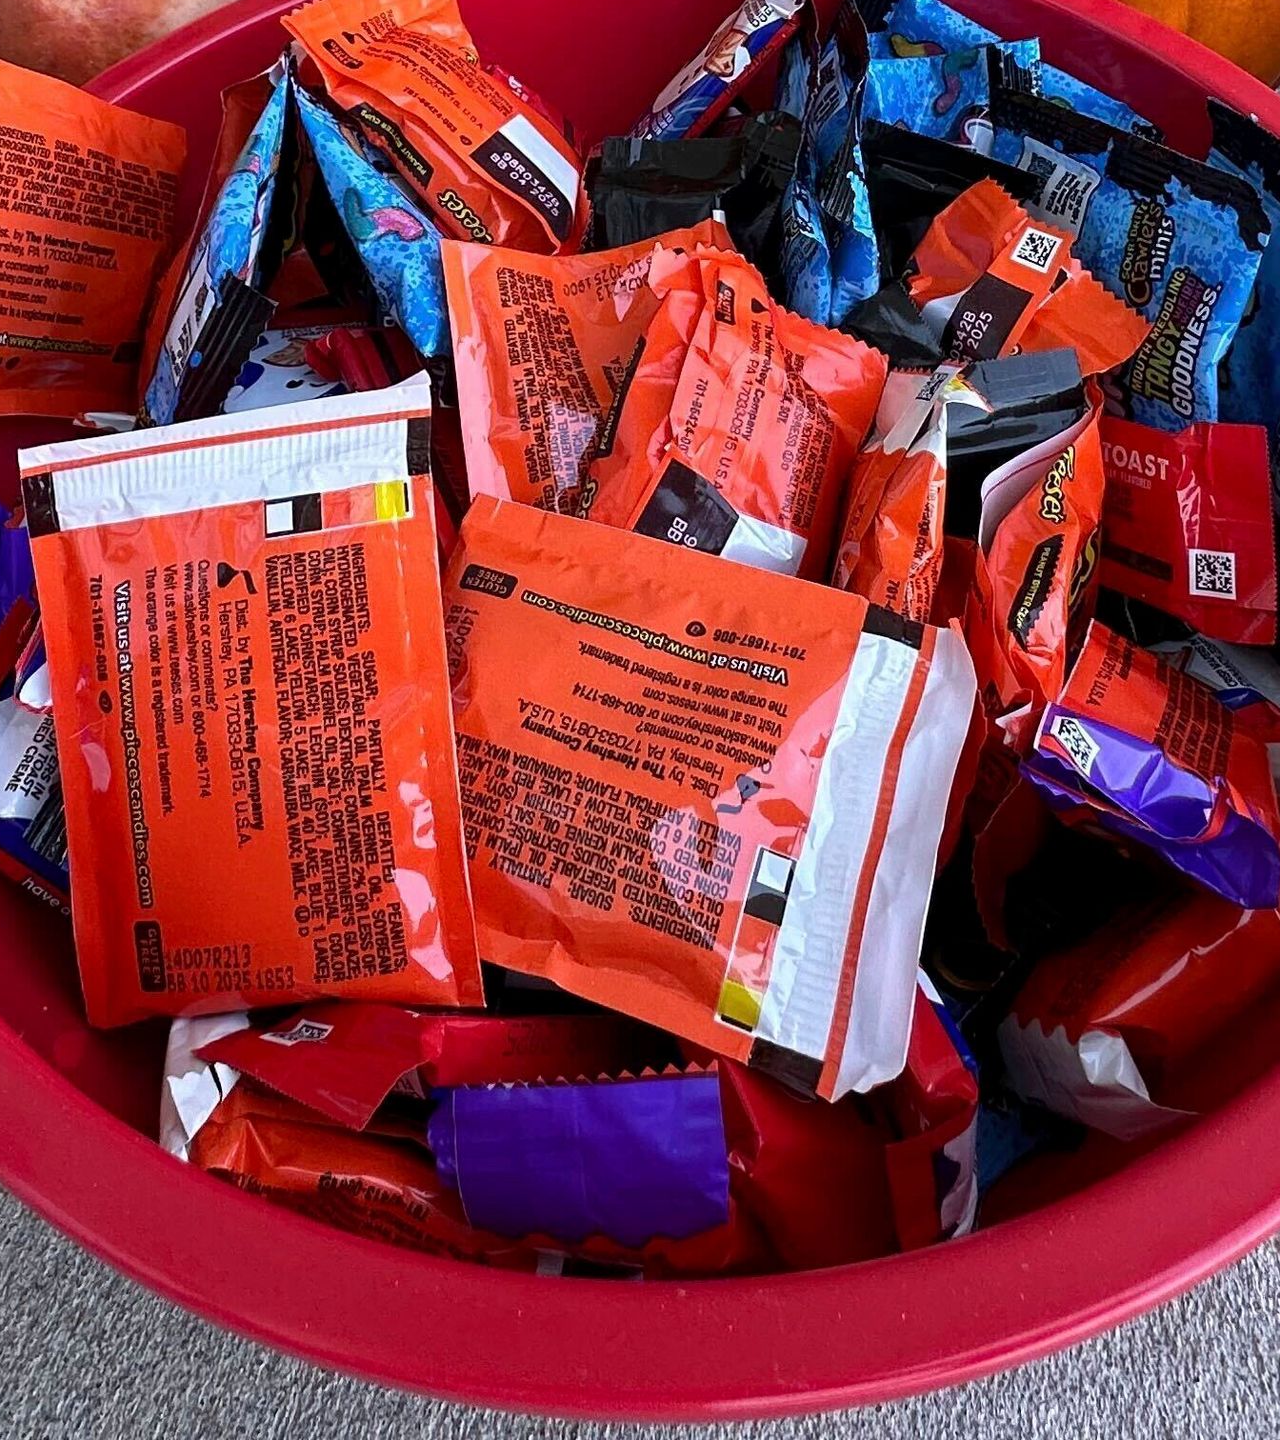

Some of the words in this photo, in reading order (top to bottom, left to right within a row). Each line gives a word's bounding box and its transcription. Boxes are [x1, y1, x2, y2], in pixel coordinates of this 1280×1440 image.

[489, 152, 508, 170] BB
[529, 188, 560, 217] 2025
[501, 151, 560, 208] 98R0342B
[439, 190, 492, 242] eese's
[1121, 243, 1135, 280] SOUR
[1127, 203, 1161, 303] Crawlers
[1149, 218, 1173, 279] minis
[503, 318, 520, 365] DEFATTED
[967, 311, 994, 351] 2025
[745, 358, 759, 375] PA
[1130, 343, 1153, 393] MOUTH
[1171, 284, 1222, 416] GOODNESS.
[741, 387, 766, 442] Company
[1102, 441, 1169, 481] TOAST
[1042, 444, 1075, 524] Reese's
[143, 566, 158, 589] The
[161, 564, 179, 590] Visit
[306, 550, 323, 585] CORN
[477, 569, 505, 584] FREE
[1034, 547, 1052, 583] PEANUT
[164, 593, 175, 607] us
[193, 558, 215, 621] Questions
[291, 552, 311, 615] MODIFIED
[324, 578, 339, 614] CORN
[334, 545, 359, 647] HYDROGENATED
[465, 576, 508, 595] GLUTEN
[112, 581, 132, 624] Visit
[142, 590, 160, 632] orange
[165, 610, 178, 621] at
[233, 599, 251, 632] Dist.
[116, 627, 130, 649] us
[176, 561, 206, 693] www.askhershey.com
[199, 623, 211, 638] or
[328, 617, 344, 660] SYRUP
[519, 588, 708, 665] www.piecescandies.com
[118, 652, 132, 673] at
[148, 633, 162, 664] color
[234, 636, 251, 654] by
[315, 639, 331, 676] PALM
[707, 651, 728, 670] at
[151, 665, 163, 677] is
[151, 679, 162, 687] a
[199, 639, 218, 712] comments?
[222, 667, 238, 689] PA
[238, 656, 255, 686] The
[349, 542, 373, 633] INGREDIENTS:
[366, 718, 388, 792] PARTIALLY
[628, 659, 683, 691] registered
[727, 655, 750, 675] us
[748, 659, 789, 687] Visit
[190, 694, 201, 708] or
[318, 681, 337, 731] KERNEL
[345, 653, 366, 728] VEGETABLE
[700, 681, 730, 703] color
[728, 687, 767, 713] orange
[765, 698, 789, 718] The
[149, 689, 169, 749] registered
[237, 688, 261, 754] Hershey
[513, 695, 556, 724] U.S.A.
[352, 735, 368, 757] OIL
[518, 713, 582, 752] Company
[4, 745, 37, 792] CREME
[306, 725, 327, 788] LECITHIN
[582, 736, 640, 771] Hershey
[639, 758, 667, 780] The
[644, 741, 666, 761] PA
[666, 745, 725, 781] Hershey,
[19, 753, 49, 797] TOAST
[30, 782, 47, 801] IN
[118, 674, 154, 907] www.piecescandies.com
[666, 764, 686, 786] by
[686, 773, 719, 799] Dist.
[243, 757, 267, 831] Company
[343, 794, 363, 862] CONTAINS
[360, 814, 380, 869] KERNEL
[22, 875, 60, 907] have
[319, 848, 340, 924] ARTIFICIAL
[351, 866, 366, 887] 2%
[354, 892, 368, 912] OR
[357, 914, 373, 952] LESS
[371, 908, 392, 974] SOYBEAN
[139, 940, 151, 976] FREE
[148, 928, 161, 984] GLUTEN
[327, 932, 346, 982] COLOR
[214, 969, 252, 992] 2025
